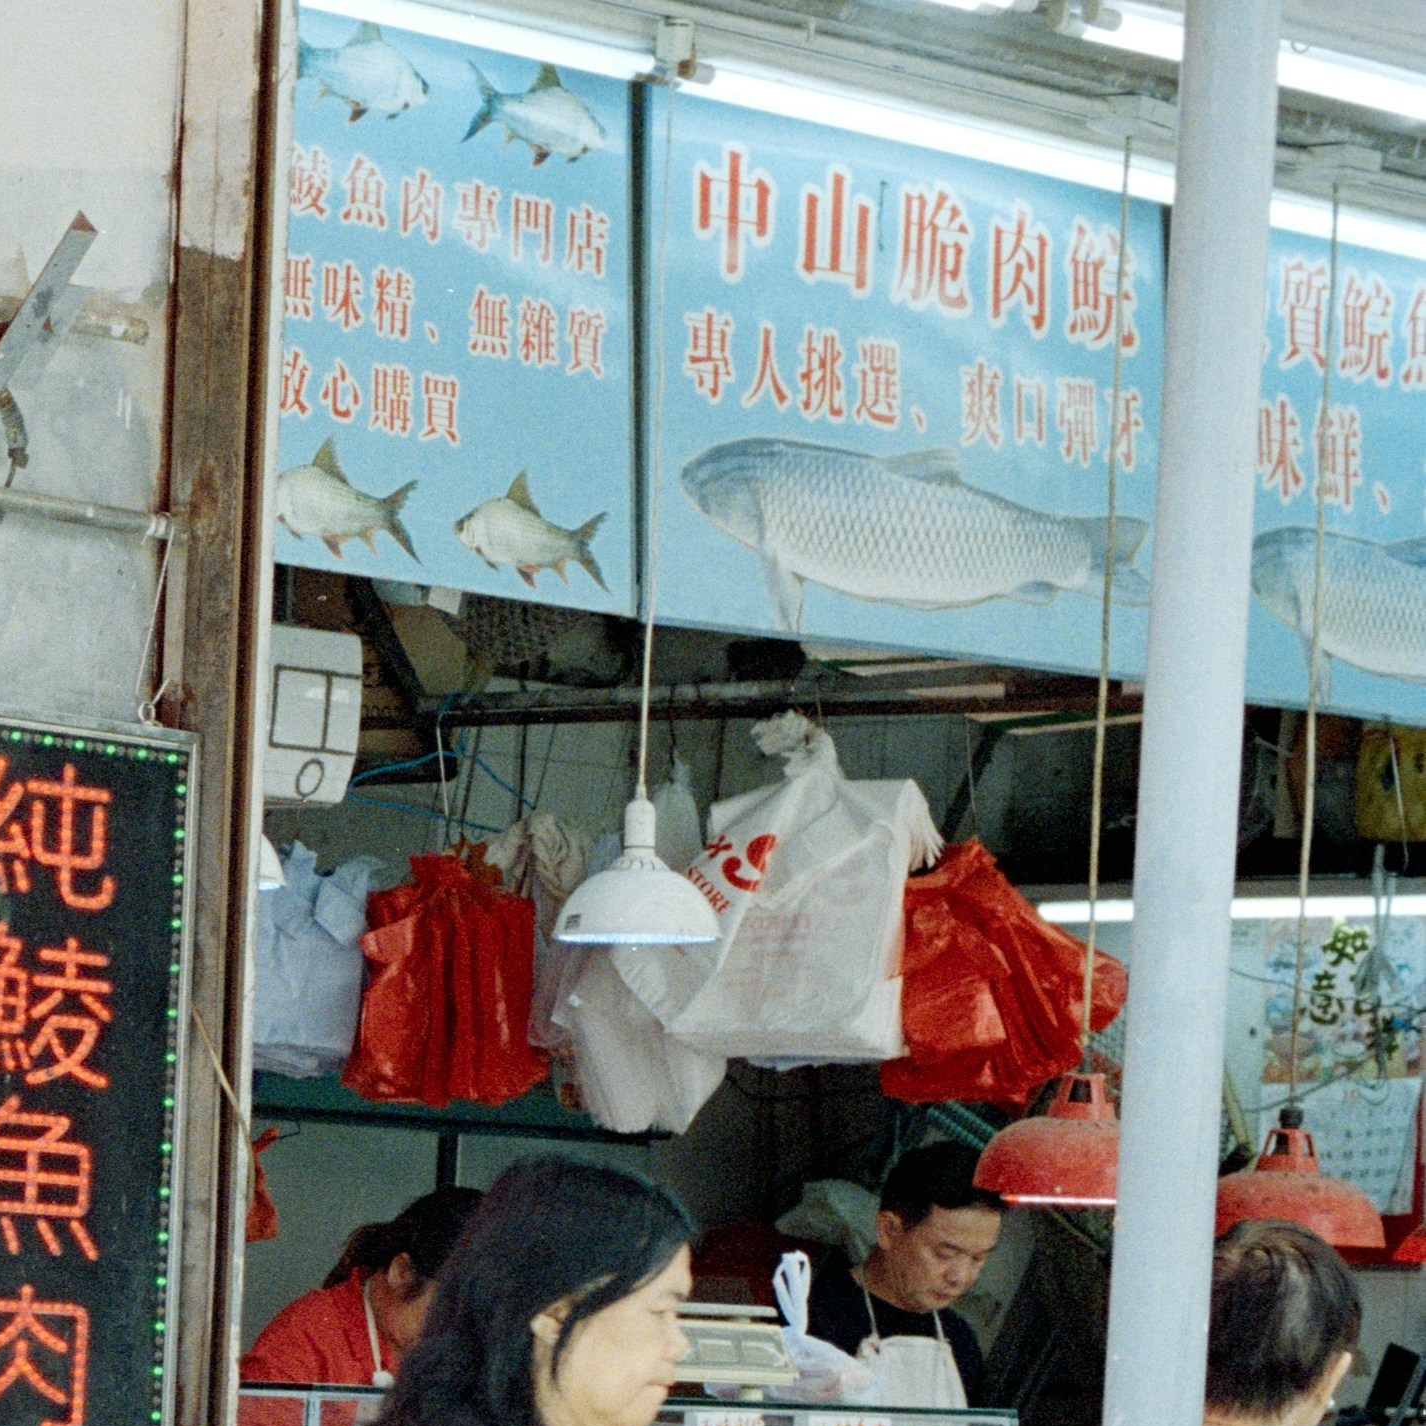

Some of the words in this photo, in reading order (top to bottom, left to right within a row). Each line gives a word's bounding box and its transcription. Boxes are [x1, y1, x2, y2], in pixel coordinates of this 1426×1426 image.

[700, 151, 1135, 347] 中山脆肉鯇
